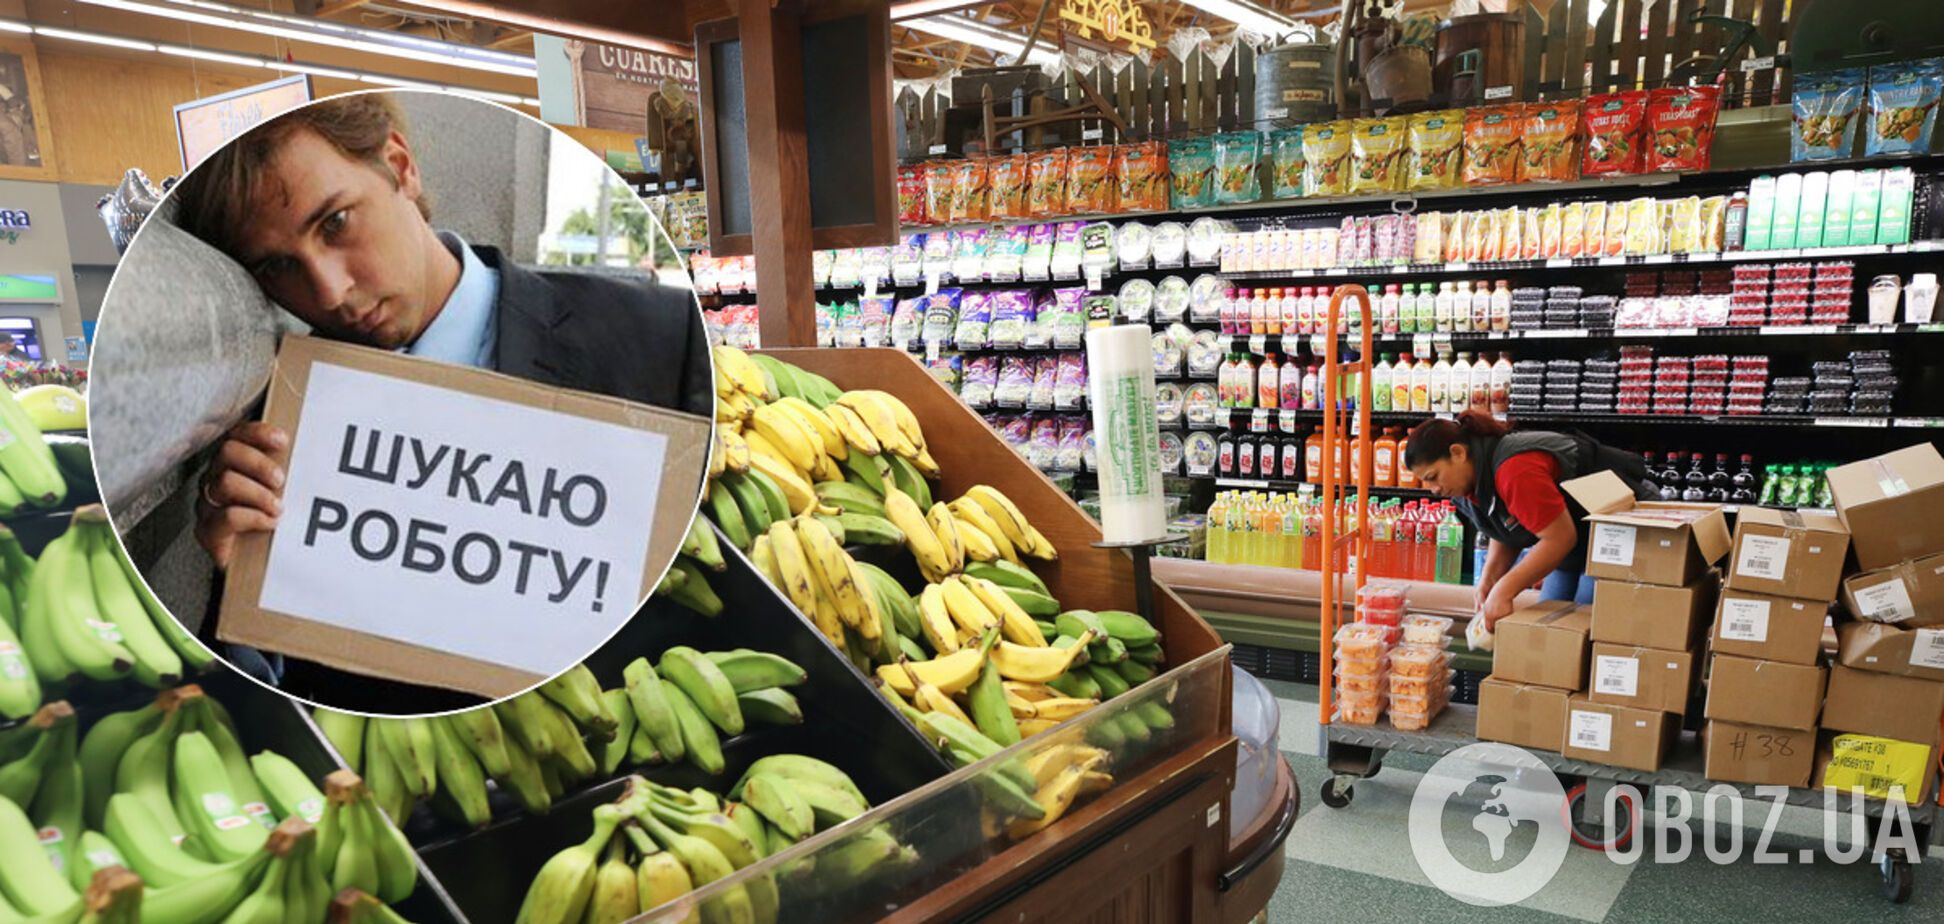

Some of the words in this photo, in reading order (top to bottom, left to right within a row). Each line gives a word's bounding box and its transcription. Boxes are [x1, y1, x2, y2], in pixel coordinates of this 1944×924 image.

[1107, 12, 1118, 36] 11
[599, 44, 700, 81] CUARES
[338, 424, 607, 526] ШУКАЮ
[304, 497, 610, 613] РОБОТУ!
[1729, 731, 1748, 761] #
[1757, 735, 1794, 758] 38
